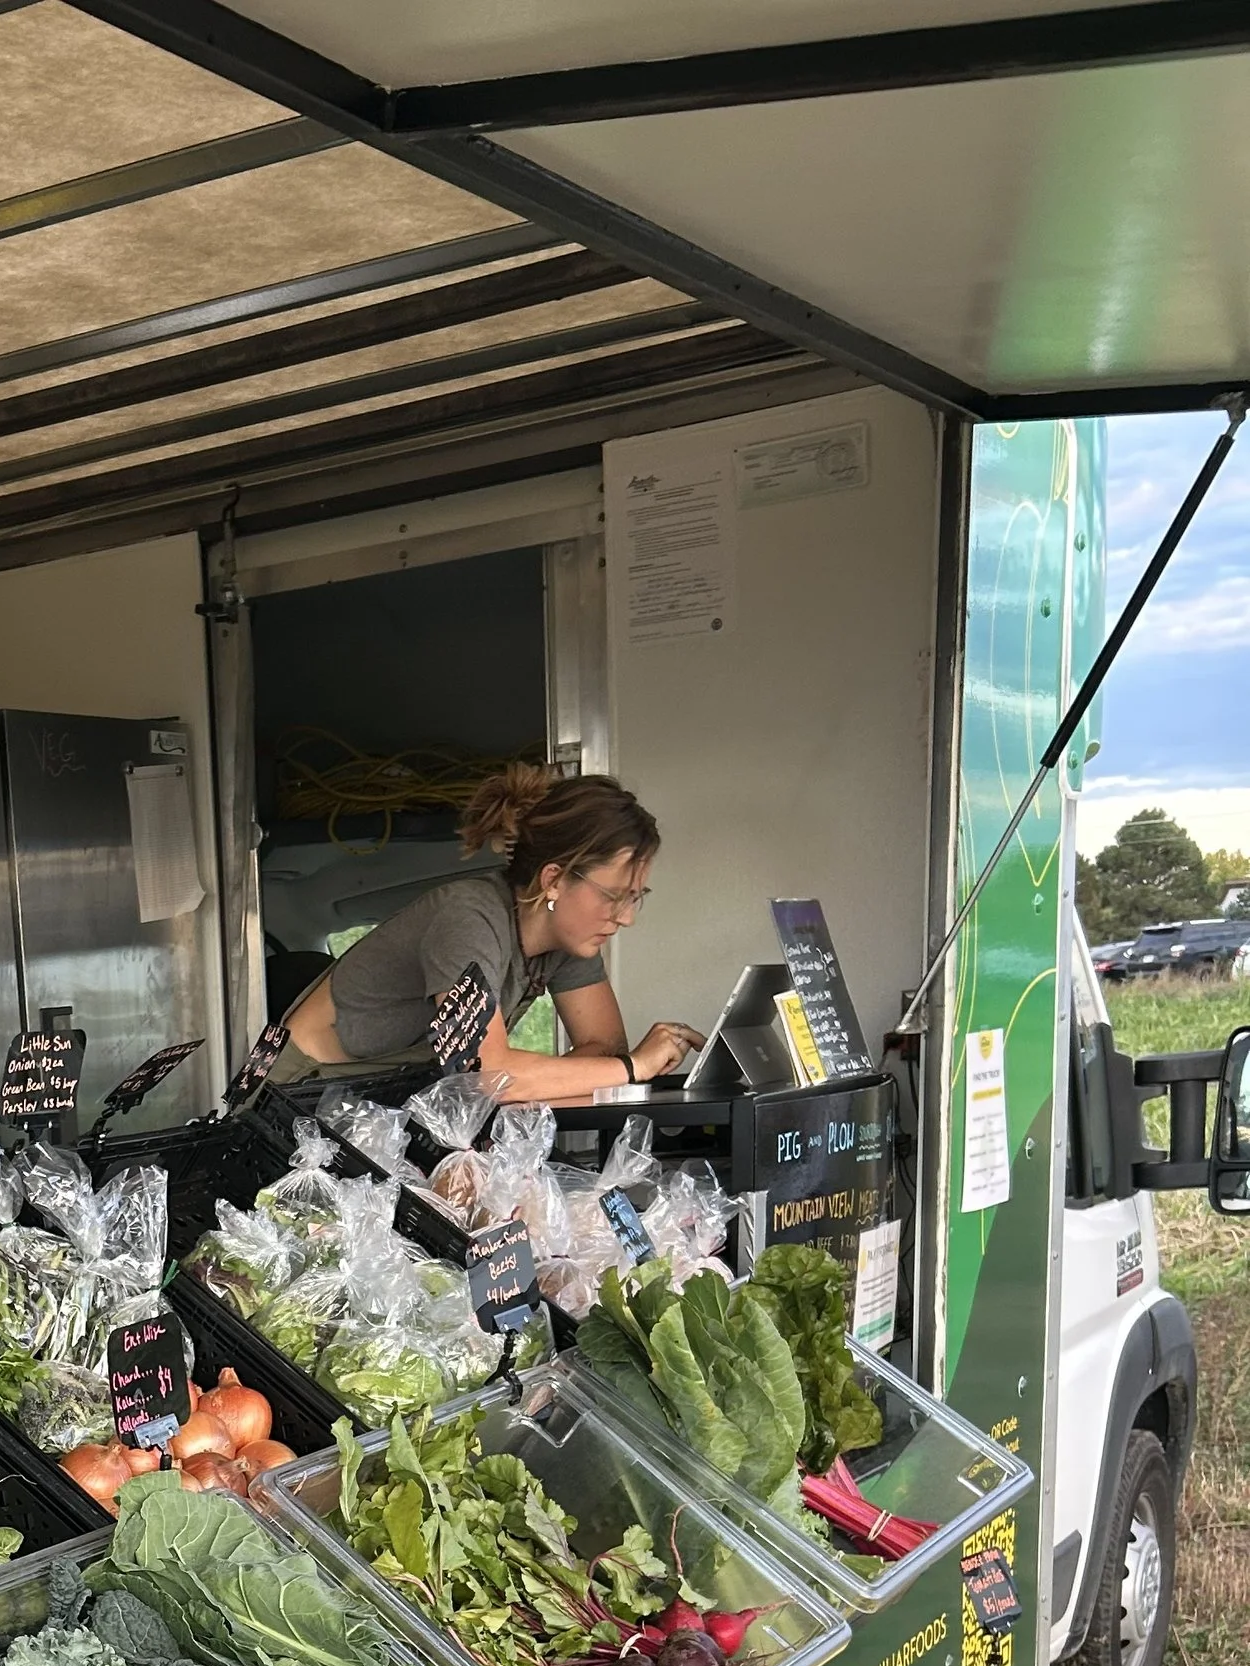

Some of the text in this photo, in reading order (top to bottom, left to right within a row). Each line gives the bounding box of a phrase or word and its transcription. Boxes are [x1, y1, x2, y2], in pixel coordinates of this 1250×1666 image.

[20, 1034, 72, 1053] Little Sun
[8, 1058, 36, 1074] Onion
[1, 1081, 24, 1097] Green
[2, 1098, 38, 1116] Parsley
[777, 1131, 801, 1163] PIG
[807, 1135, 823, 1148] AND
[828, 1121, 855, 1154] PLOW
[774, 1196, 826, 1232] MOUNTAIN
[827, 1188, 855, 1219] VIEW
[488, 1252, 520, 1280] Beets!
[1002, 1415, 1018, 1436] Code
